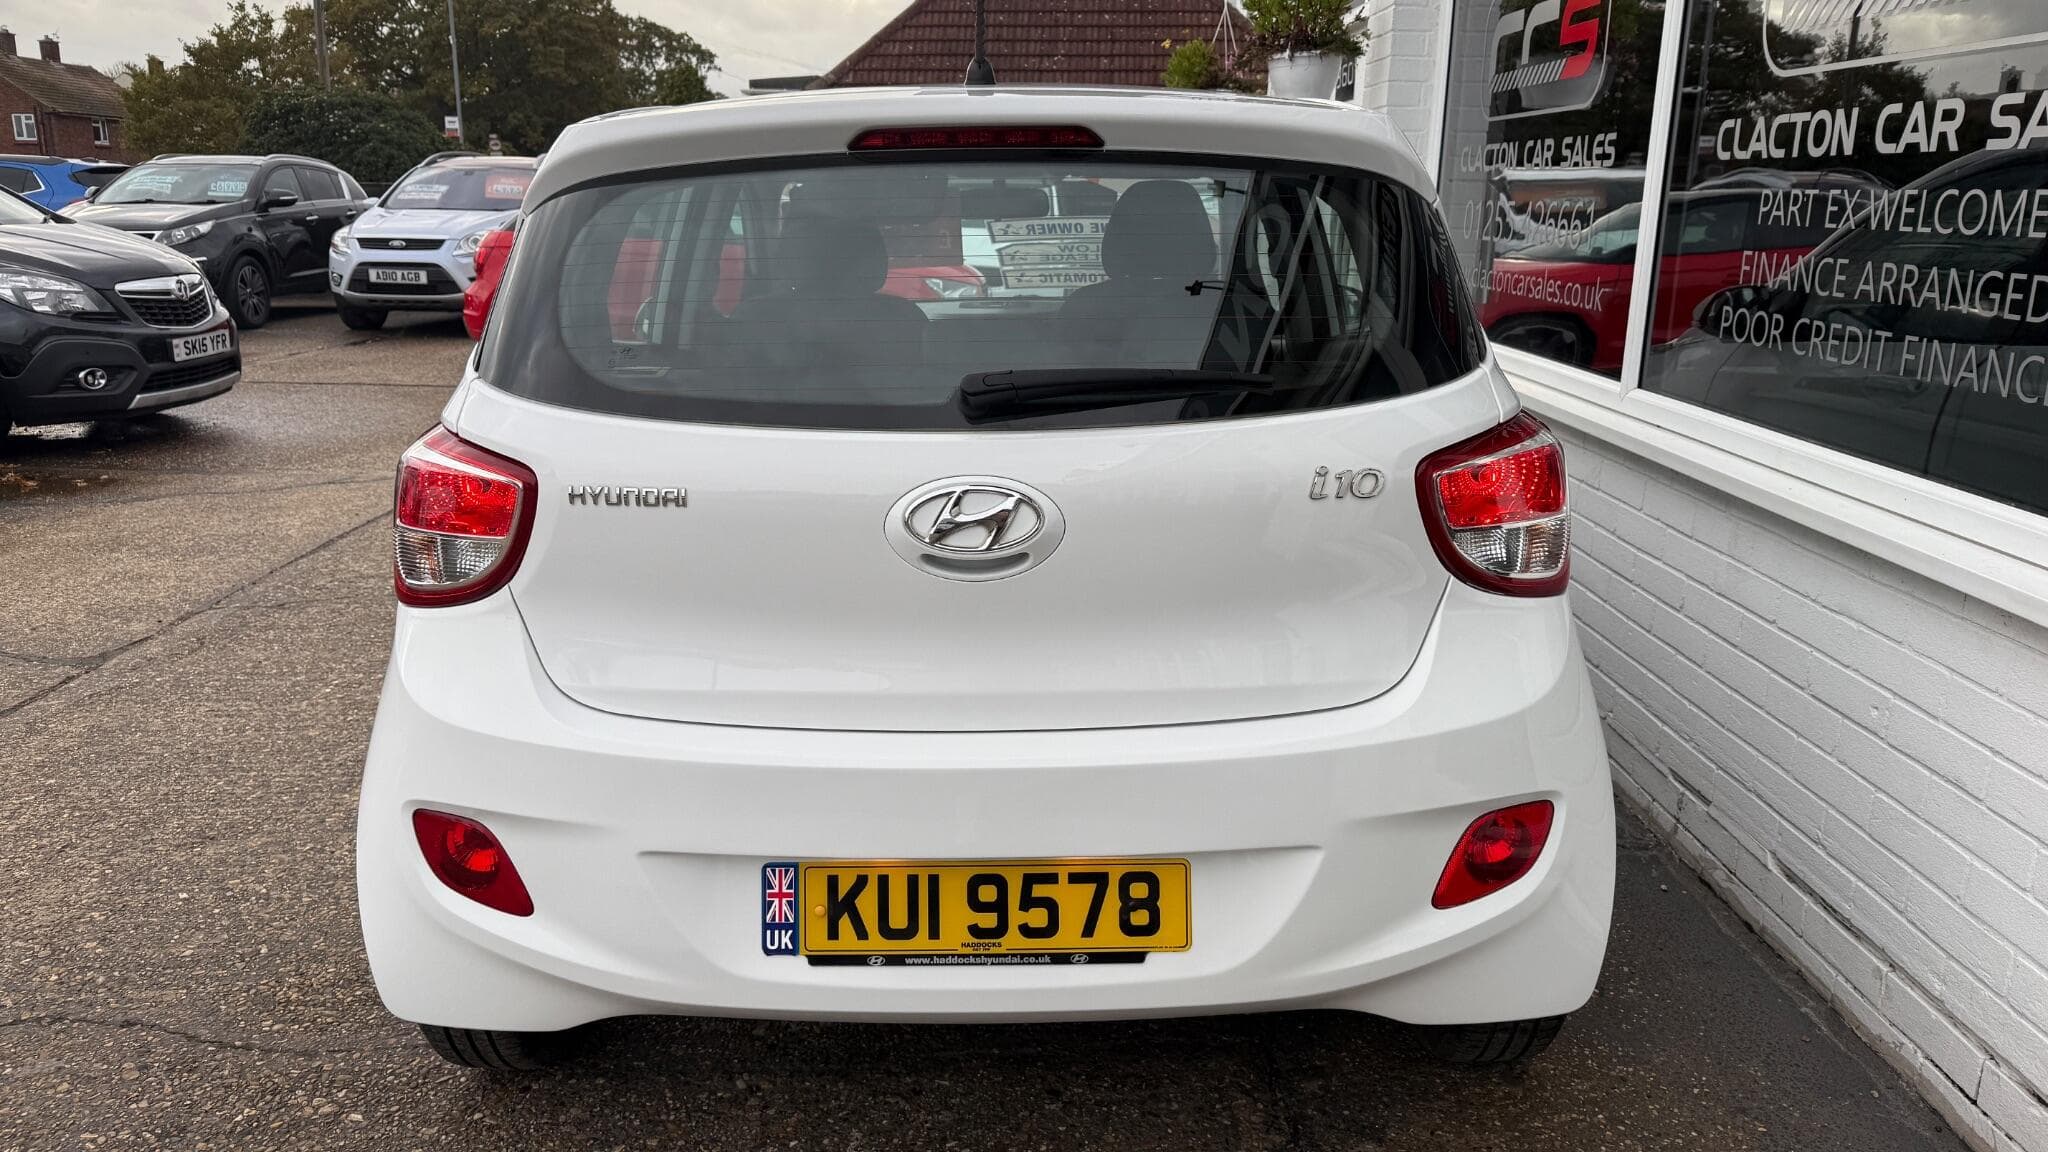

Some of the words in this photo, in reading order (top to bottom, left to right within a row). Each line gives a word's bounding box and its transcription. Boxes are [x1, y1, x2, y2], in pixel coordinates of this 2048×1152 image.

[1460, 141, 1519, 173] CLACTON
[1524, 138, 1555, 168] CAR
[1560, 132, 1617, 168] SALES
[1717, 107, 1859, 161] CLACTON
[1874, 98, 1966, 154] CAR
[1463, 200, 1516, 243] 01255
[1521, 199, 1596, 251] 426661
[1758, 189, 1820, 227] PART
[1824, 189, 1861, 229] EX
[1869, 189, 2048, 239] WELCOME
[1740, 250, 1850, 298] FINANCE
[1853, 260, 2048, 323] ARRANGED
[183, 337, 208, 356] SK15
[209, 333, 227, 351] YFR
[1719, 305, 1784, 351] POOR
[1792, 317, 1893, 372] CREDIT
[1899, 335, 2048, 407] FINANC
[568, 485, 688, 508] HYUNDAI
[1308, 466, 1385, 500] i10
[766, 930, 793, 949] UK
[827, 874, 940, 940] KUI
[967, 871, 1161, 940] 9578
[905, 954, 1051, 966] www.haddockshyundai.co.uk
